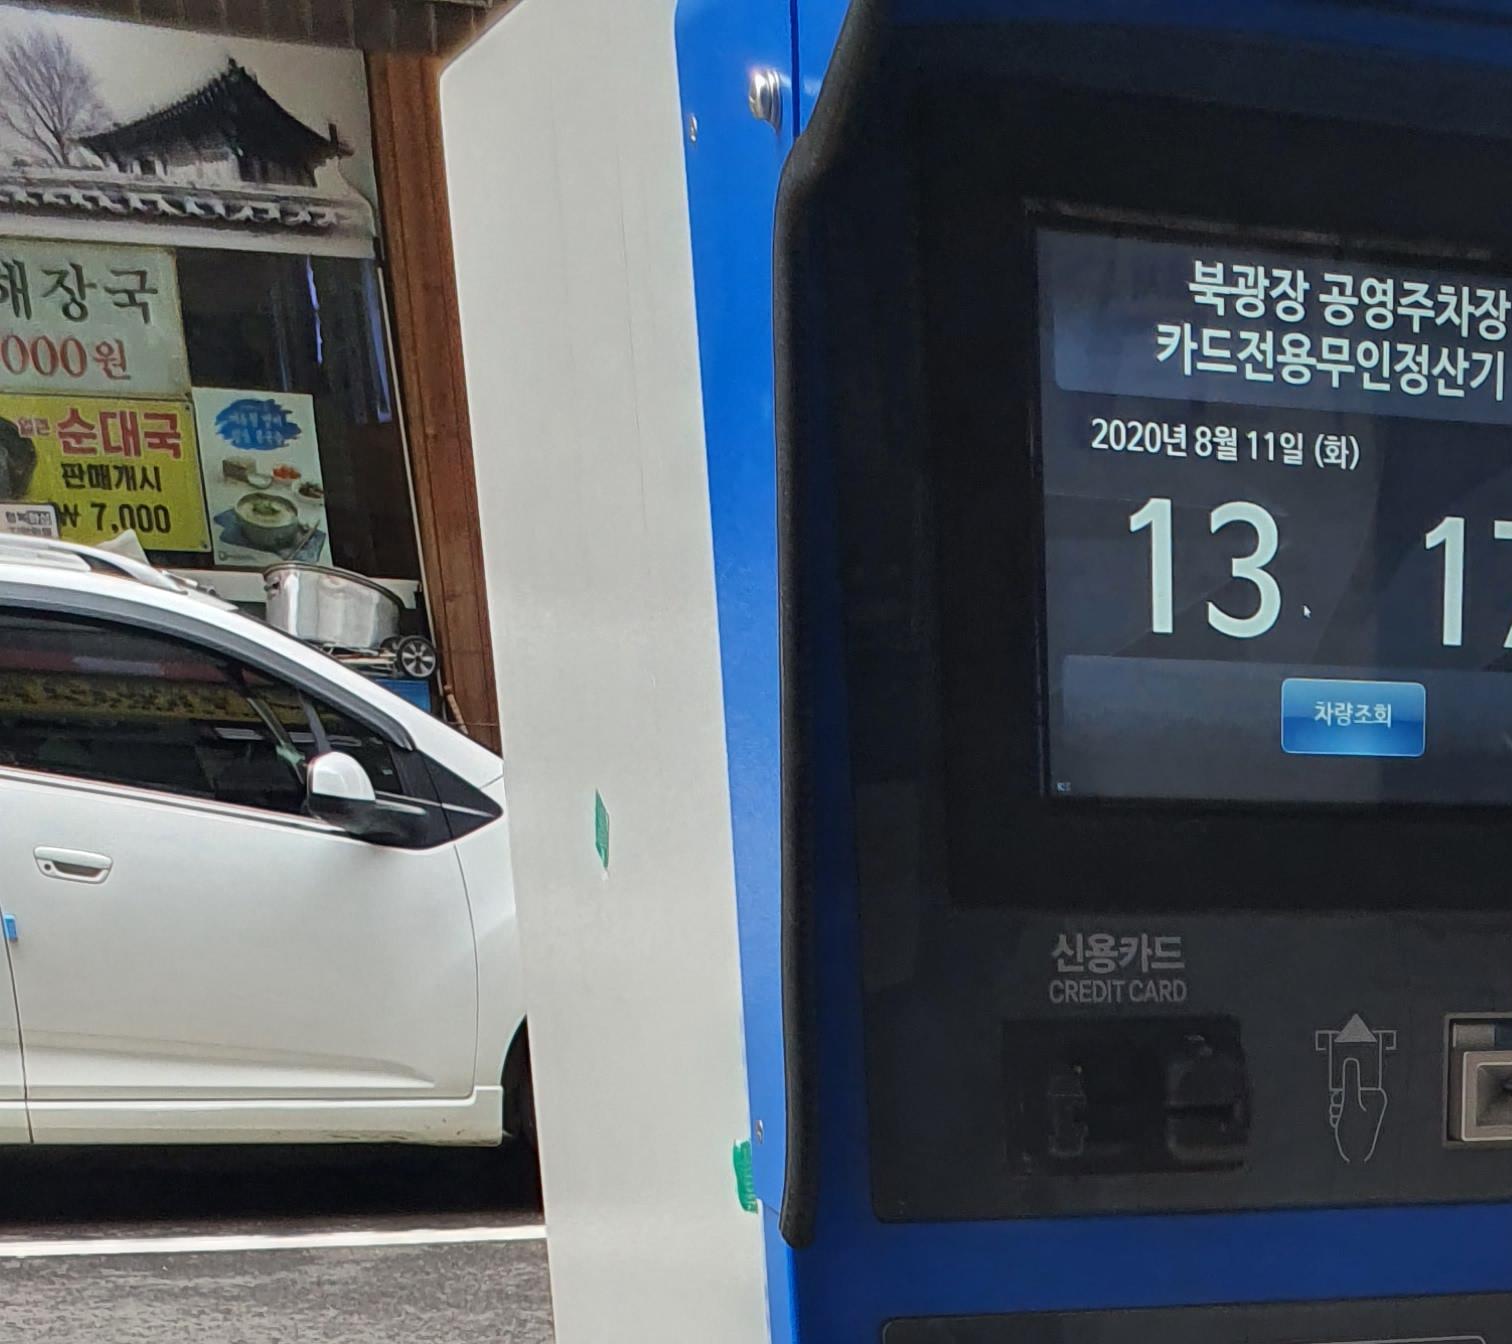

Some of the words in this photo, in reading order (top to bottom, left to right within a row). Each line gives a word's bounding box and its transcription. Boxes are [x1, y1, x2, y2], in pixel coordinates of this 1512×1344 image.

[1189, 259, 1310, 321] 북광장
[1319, 272, 1511, 341] 공영주차장
[1156, 322, 1505, 402] 카드전용무인정산기
[56, 406, 183, 459] 순대국
[1091, 418, 1188, 458] 2020년
[1194, 426, 1238, 462] 8월
[1247, 430, 1304, 467] 11일
[1314, 434, 1360, 471] (화)
[60, 463, 162, 492] 판매개시
[1129, 497, 1282, 639] 13
[1313, 701, 1393, 729] 차량조회
[1051, 934, 1186, 974] 신용카드
[1049, 980, 1125, 1004] CREDIT
[1129, 978, 1187, 1003] CARD
